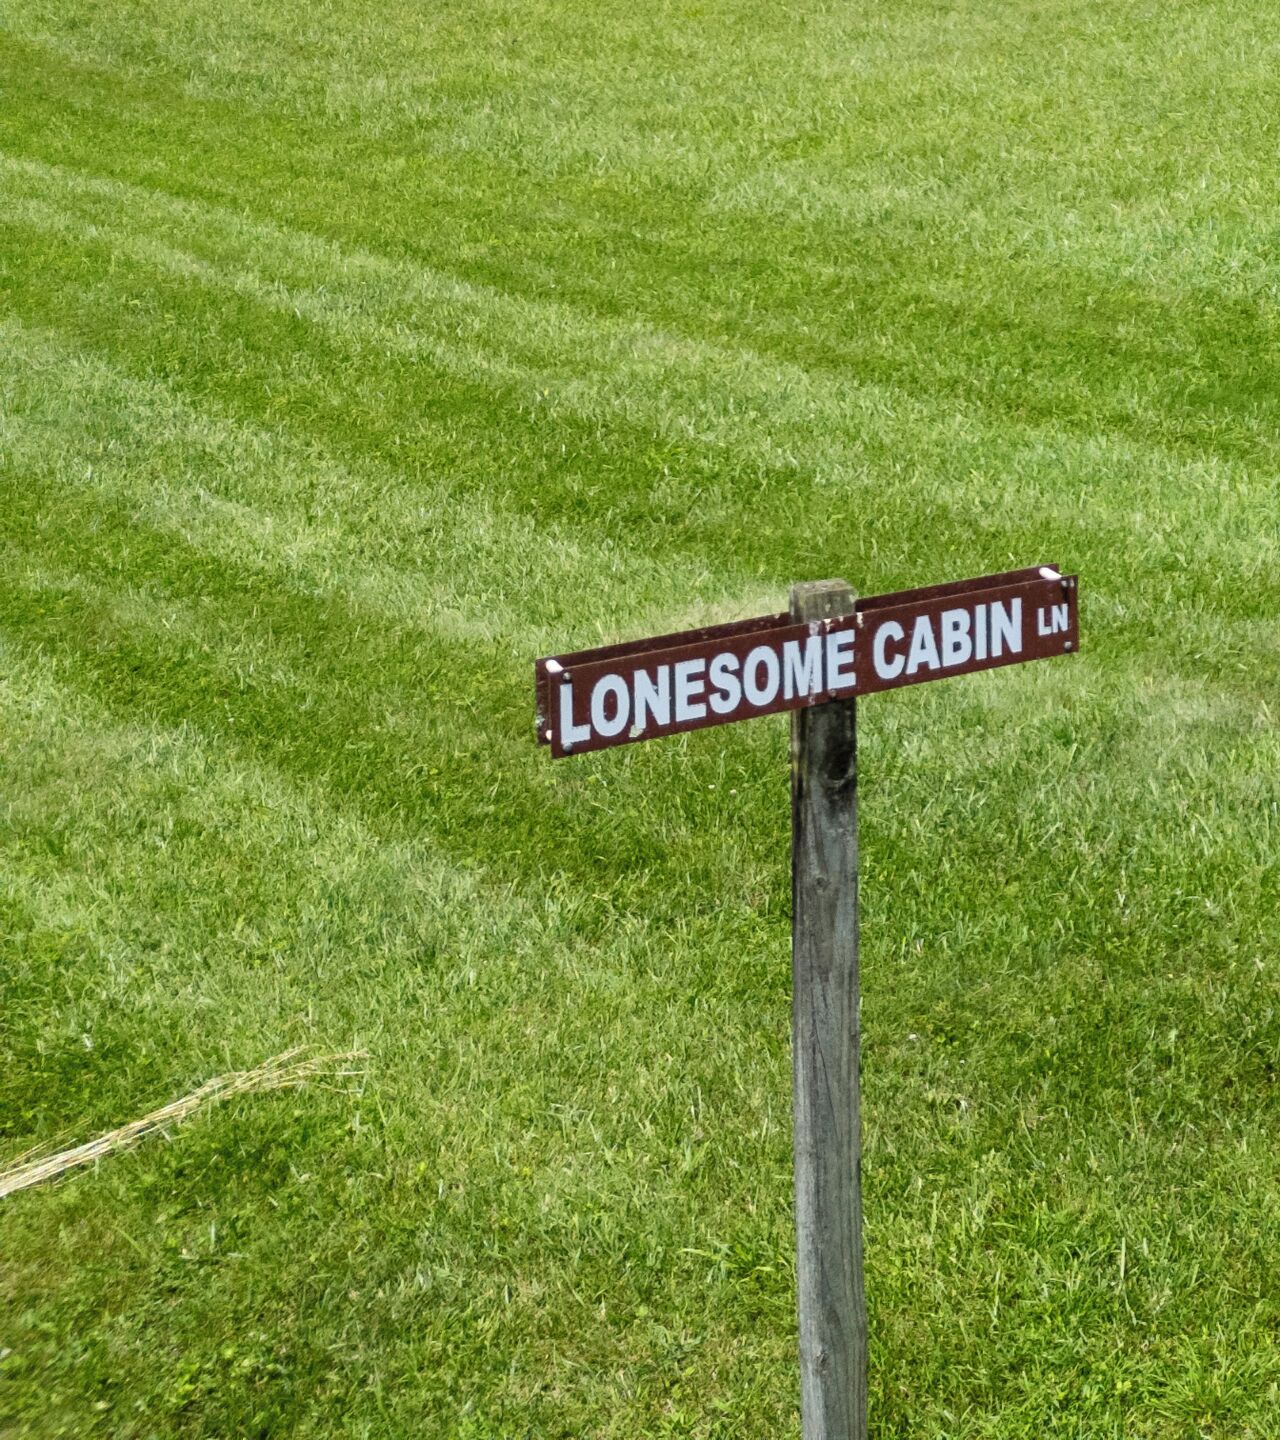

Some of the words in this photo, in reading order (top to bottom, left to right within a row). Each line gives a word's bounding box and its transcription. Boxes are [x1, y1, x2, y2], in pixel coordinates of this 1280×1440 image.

[558, 628, 857, 746] LONESOME
[872, 596, 1023, 680] CABIN
[1037, 602, 1069, 637] LN
